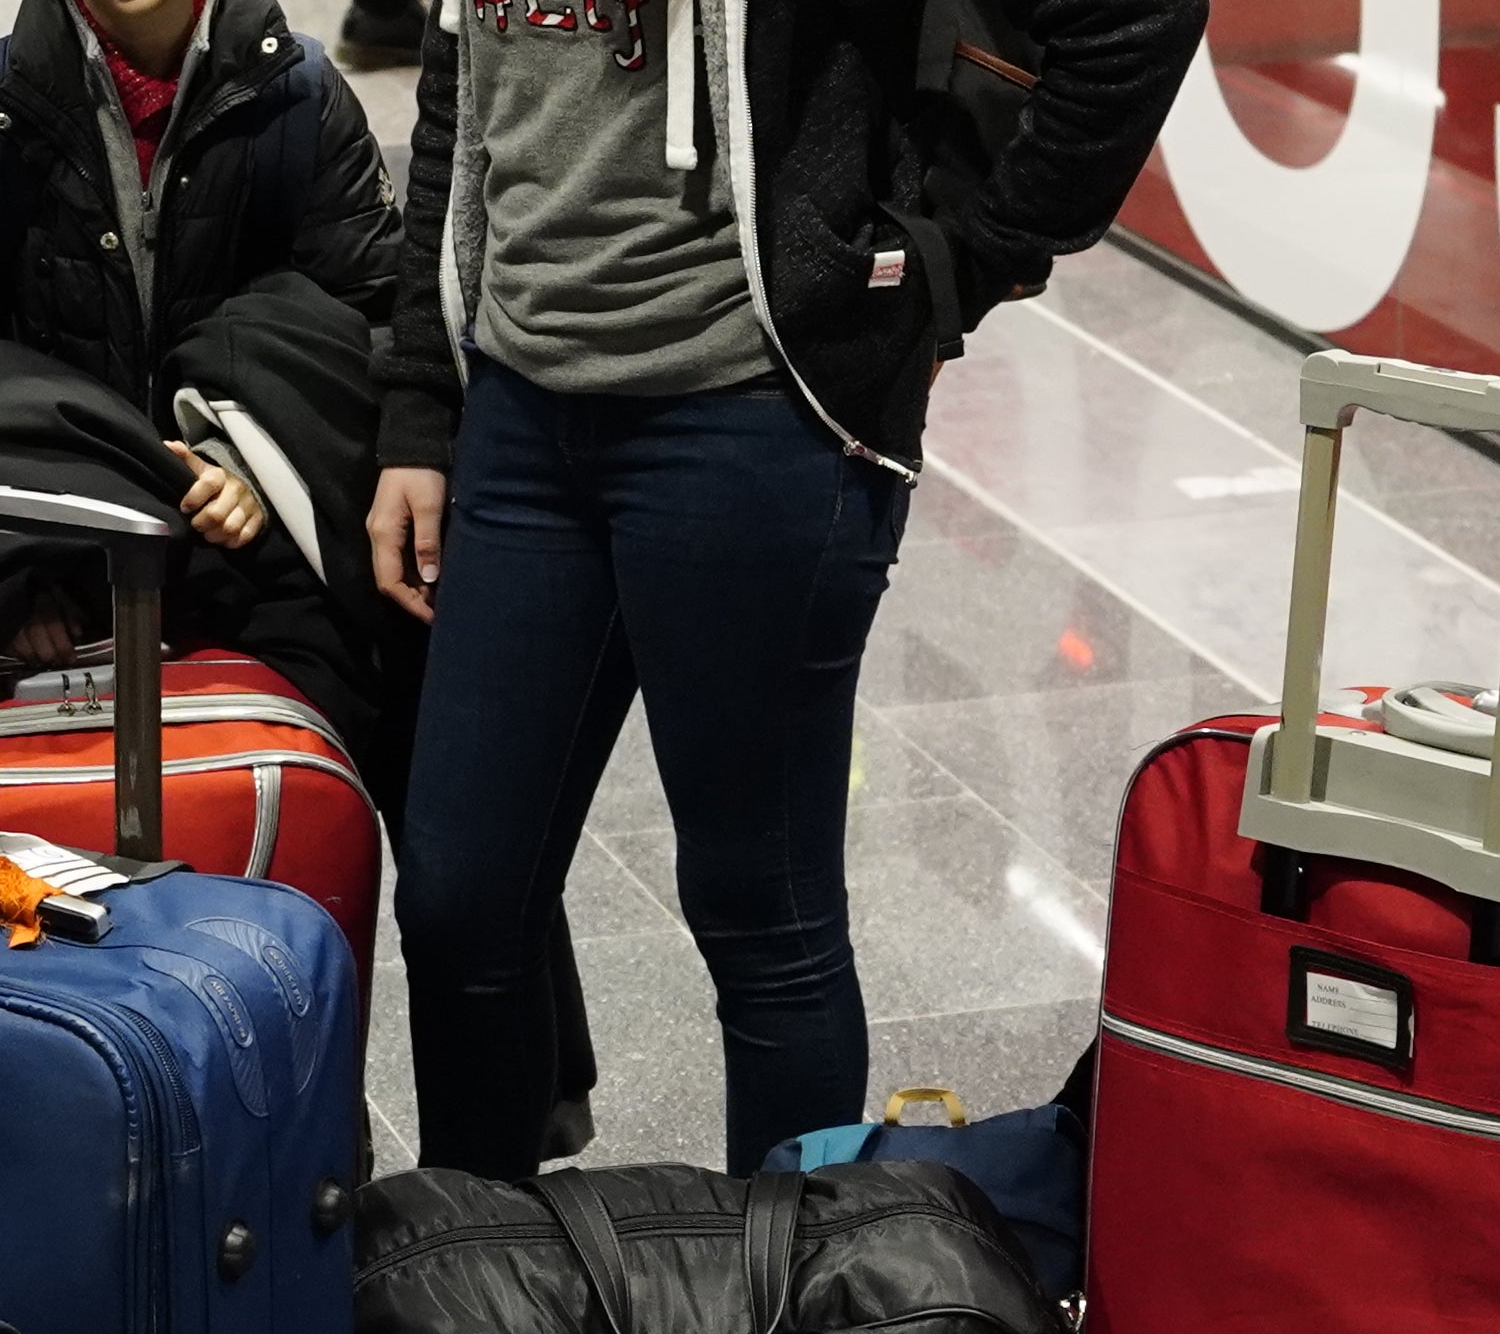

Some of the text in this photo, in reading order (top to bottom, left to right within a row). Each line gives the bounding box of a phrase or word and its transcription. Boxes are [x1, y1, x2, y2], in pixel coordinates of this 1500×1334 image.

[1317, 983, 1340, 994] NAME
[1310, 995, 1347, 1008] ADDRESS
[1311, 1020, 1359, 1037] TELEPHONE
